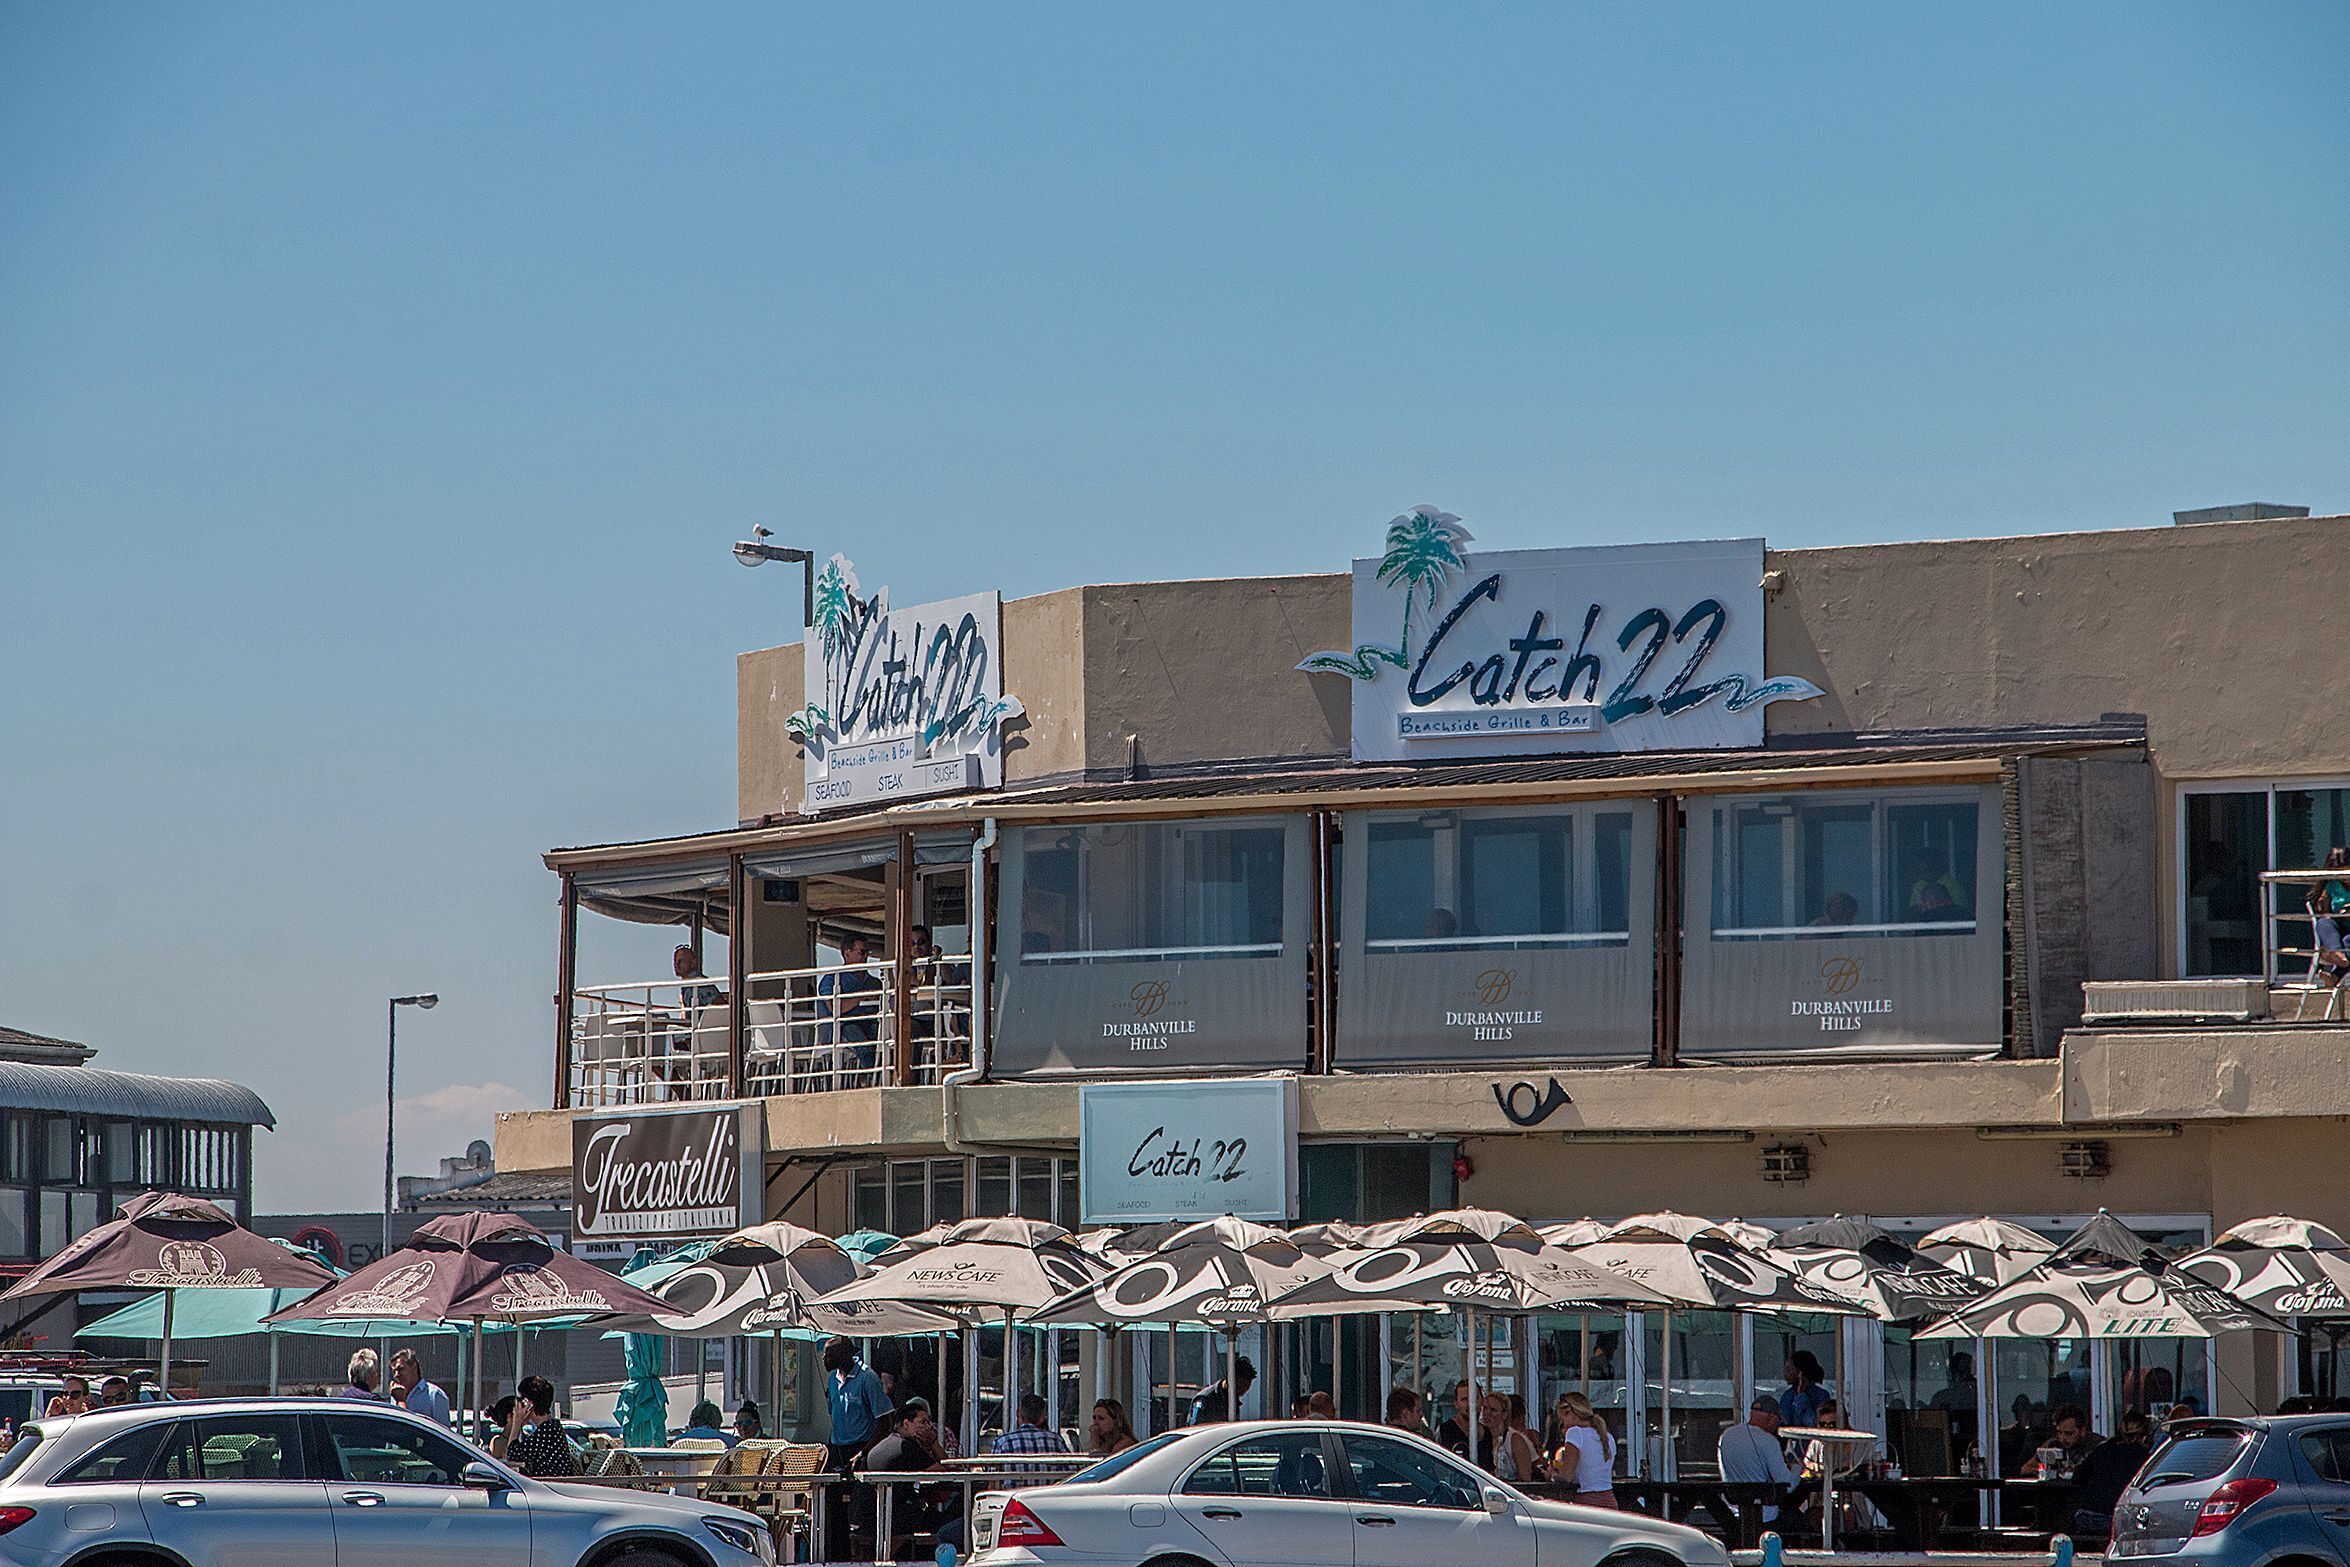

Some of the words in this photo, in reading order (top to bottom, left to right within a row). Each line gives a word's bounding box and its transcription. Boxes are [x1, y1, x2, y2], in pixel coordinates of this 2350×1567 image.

[1408, 573, 1602, 707] Catch
[1601, 598, 1729, 724] 22
[838, 594, 923, 735] Catch
[924, 612, 980, 748] 22
[1401, 717, 1480, 734] Beachside
[1488, 715, 1531, 728] Grille
[1540, 714, 1550, 727] &
[1558, 710, 1588, 726] Bar
[868, 748, 889, 765] Grille
[891, 750, 897, 761] &
[899, 743, 913, 760] Bar
[815, 780, 852, 801] SEAFOOD
[878, 773, 903, 792] STEAK
[933, 763, 960, 783] SUSHI
[1446, 1011, 1542, 1026] DURBANVILLE
[1791, 1000, 1893, 1016] DURBANVILLE
[1103, 1020, 1196, 1037] DURBANVILLE
[1474, 1027, 1513, 1041] HILLS
[1820, 1016, 1861, 1031] HILLS
[1130, 1037, 1168, 1051] HILLS
[1128, 1126, 1201, 1177] Catch
[1203, 1137, 1249, 1183] 22
[577, 1114, 736, 1234] Trecastelli
[1117, 1200, 1151, 1209] SEAFOOD
[1174, 1200, 1198, 1208] STEAK
[1224, 1199, 1248, 1207] SUSHI
[604, 1213, 673, 1232] TRADIZIONE
[678, 1209, 733, 1228] ITALIANA
[907, 1270, 957, 1280] NEWS
[957, 1270, 1001, 1282] CAFE
[1921, 1273, 1979, 1296] CAFE
[1442, 1278, 1512, 1301] Corona
[1197, 1296, 1260, 1317] Corona
[2274, 1292, 2345, 1313] Corona
[2103, 1317, 2184, 1334] LITE
